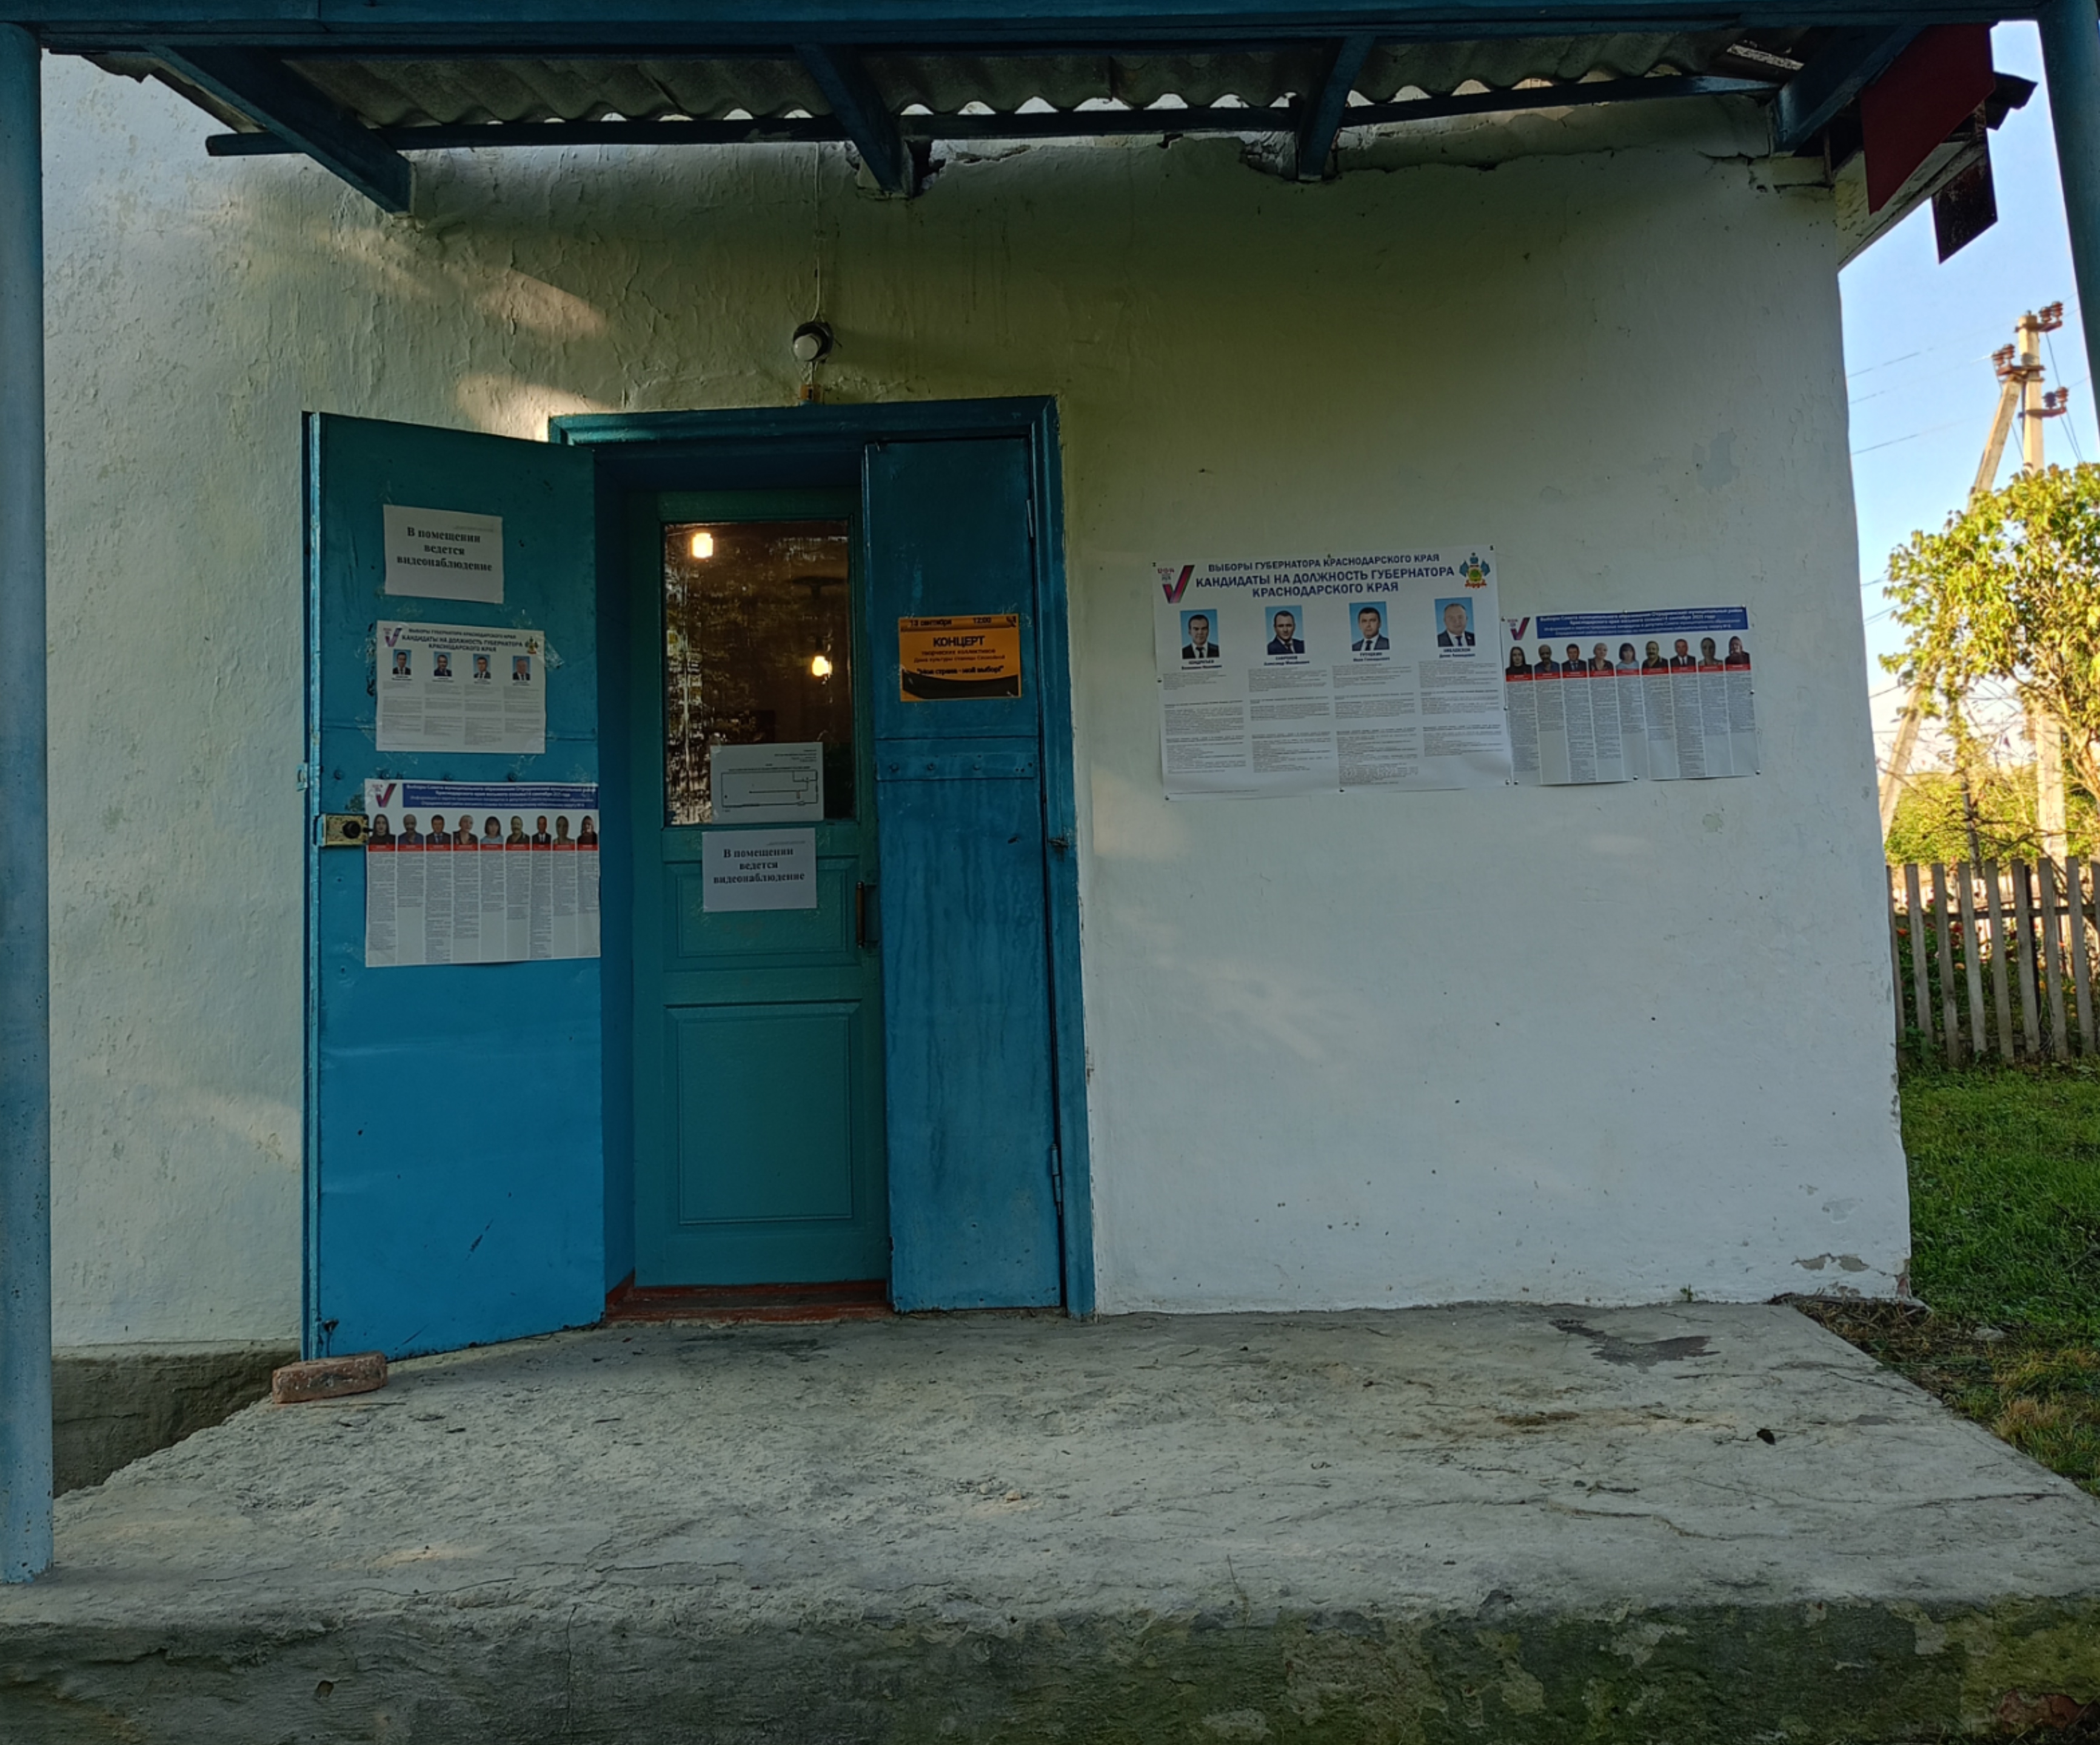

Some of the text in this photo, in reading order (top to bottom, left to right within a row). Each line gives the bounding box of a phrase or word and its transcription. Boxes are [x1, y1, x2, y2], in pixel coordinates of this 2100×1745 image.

[407, 526, 481, 542] В помещении
[424, 544, 465, 555] ведется
[396, 556, 492, 572] видеонаблюдение
[1208, 554, 1439, 572] ВЫБОРЫ ГУБЕРНАТОРА КРАСНОДАРСКОГО КРАЯ
[1196, 566, 1454, 589] КАНДИДАТЫ НА ДОЛЖНОСТЬ ГУБЕРНАТОРА
[1252, 581, 1399, 598] КРАСНОДАРСКОГО КРАЯ
[933, 636, 985, 647] КОНЦЕРТ
[723, 847, 794, 858] В помещении
[739, 861, 778, 870] ведется
[713, 872, 805, 884] видеонаблюдение
